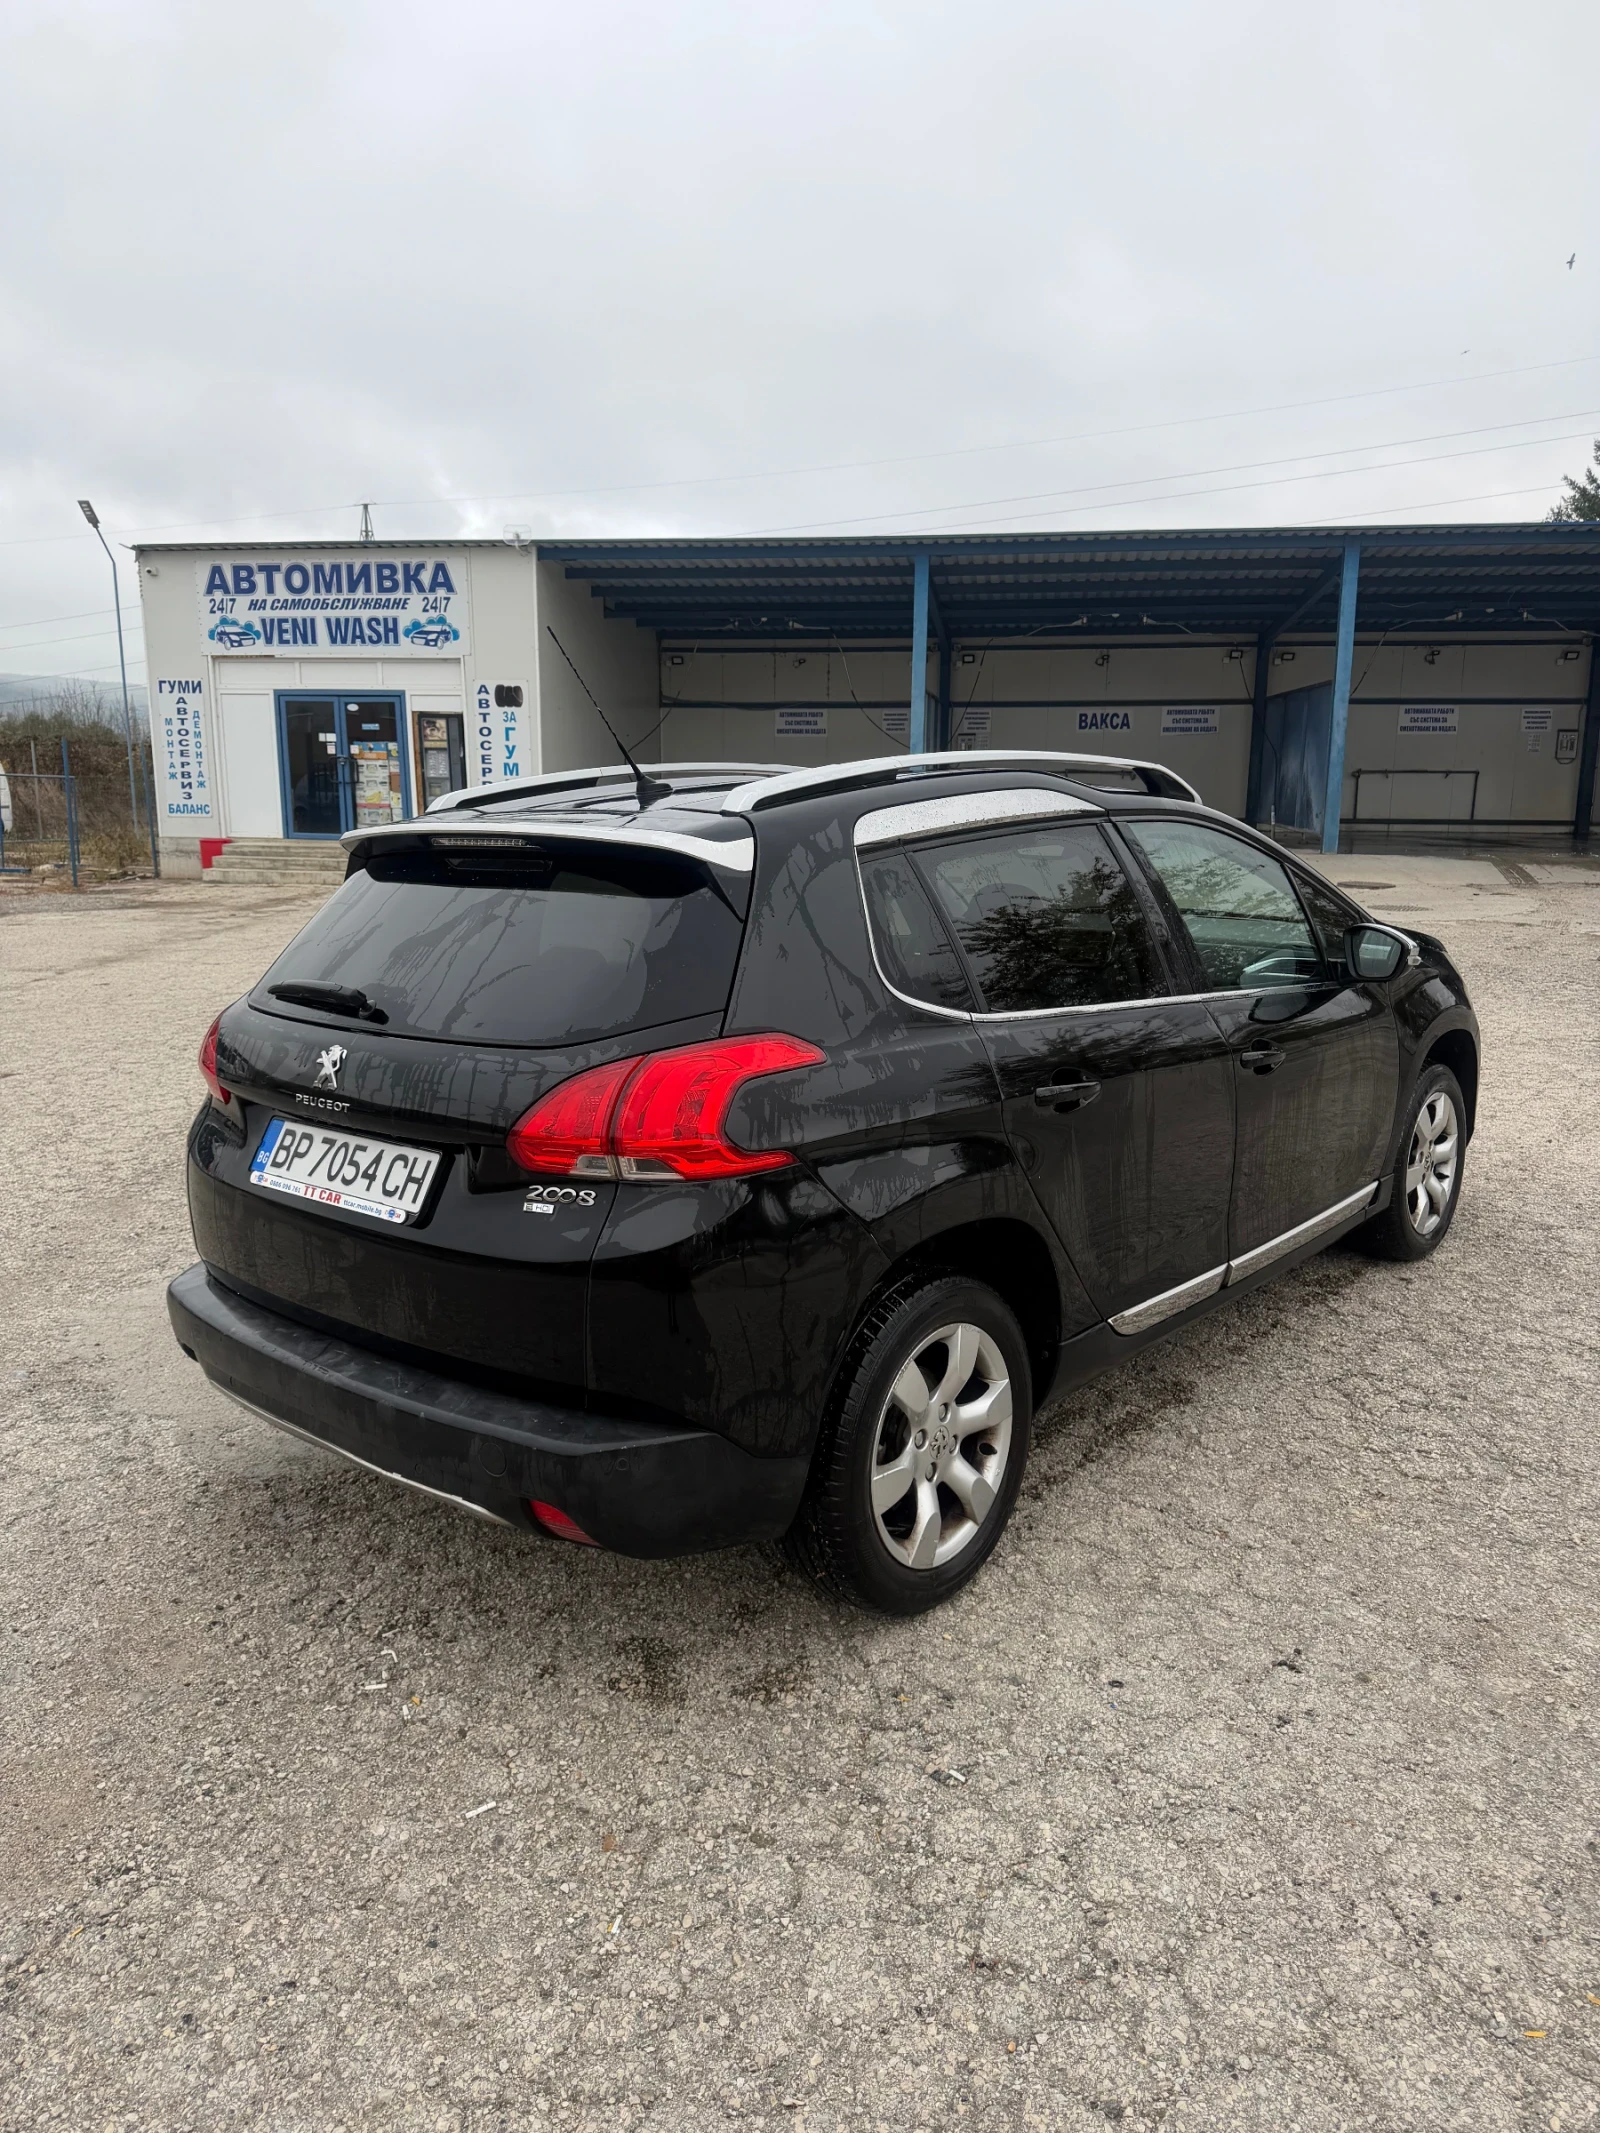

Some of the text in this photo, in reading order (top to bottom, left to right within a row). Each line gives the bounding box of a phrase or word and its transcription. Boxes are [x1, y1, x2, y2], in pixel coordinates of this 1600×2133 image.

[203, 562, 457, 596] АВТОМИВКА
[247, 598, 268, 611] НА
[269, 597, 411, 611] САМООБСЛУЖВАНЕ
[259, 615, 401, 646] VENI WASH
[158, 680, 203, 694] ГУМИ
[502, 711, 517, 723] ЗА
[1078, 712, 1131, 730] ВАКСА
[164, 717, 178, 780] МОНТАЖ
[175, 696, 193, 801] АВТОСЕРВИЗ
[192, 710, 206, 789] ДЕМОНТАЖ
[502, 726, 519, 780] ГУМ
[168, 803, 210, 815] БАЛАНС
[295, 1093, 351, 1113] PEUGEOT
[256, 1150, 270, 1164] BG
[307, 1136, 385, 1192] 7054
[303, 1185, 318, 1198] TT
[319, 1189, 343, 1205] CAR
[526, 1185, 597, 1206] 2008
